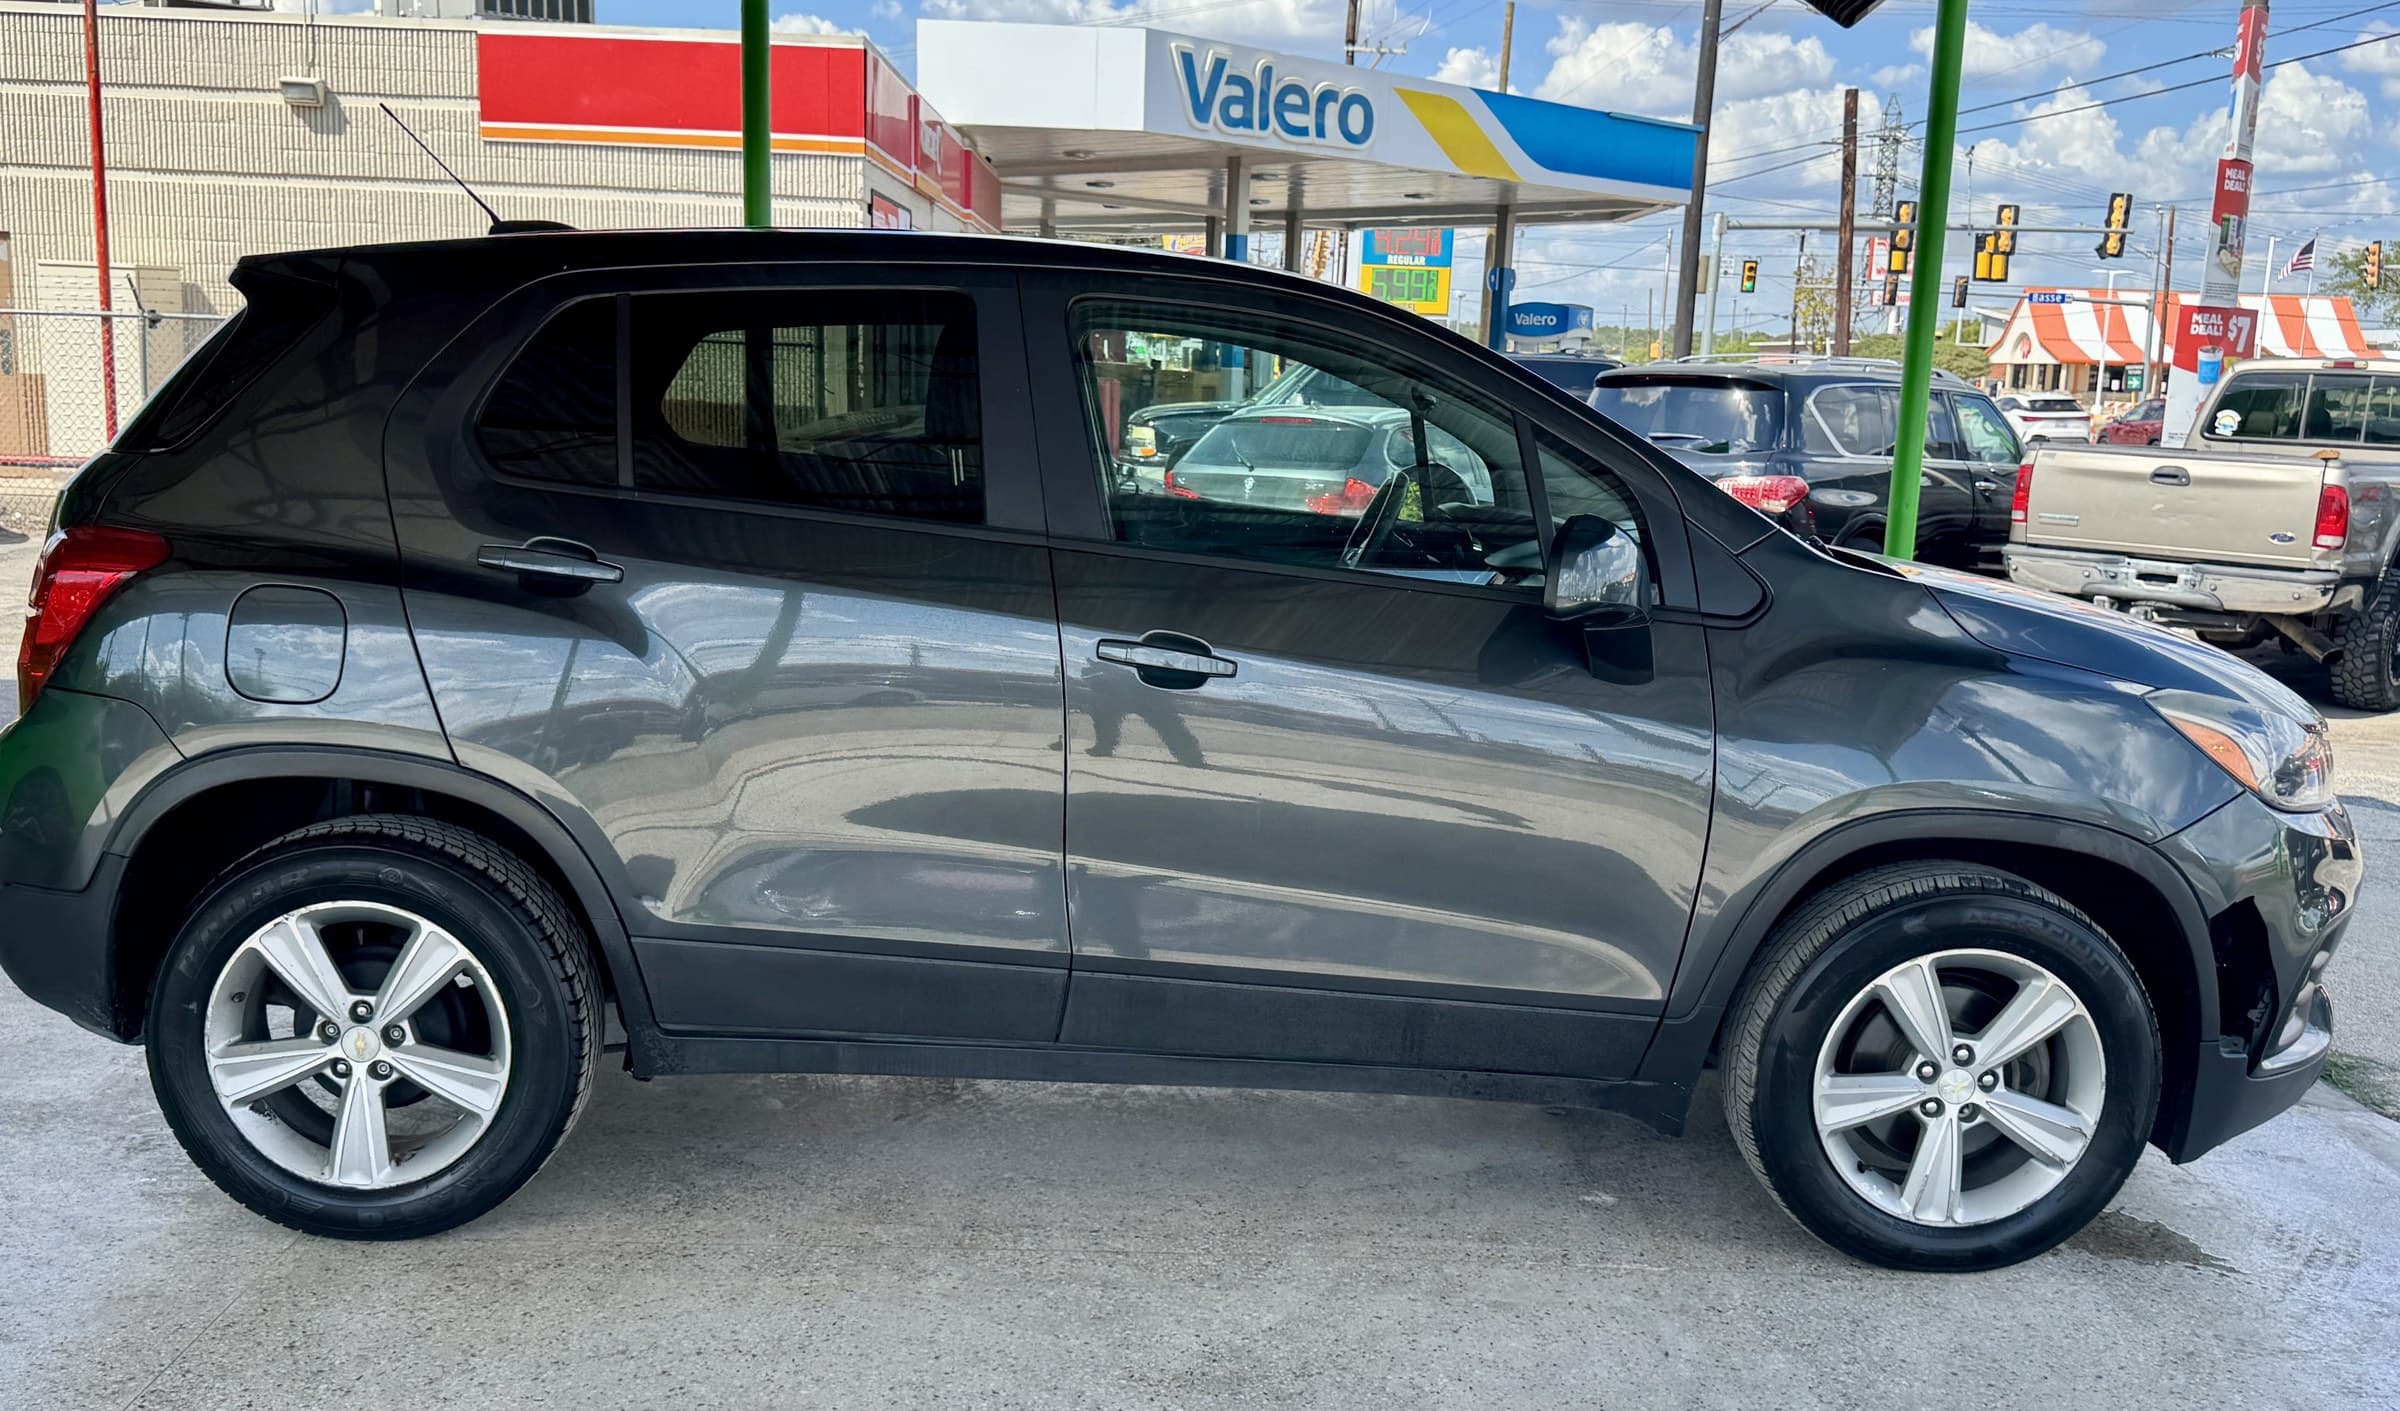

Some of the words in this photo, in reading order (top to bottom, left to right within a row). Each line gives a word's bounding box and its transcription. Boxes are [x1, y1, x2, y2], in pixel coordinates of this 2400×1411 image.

[1179, 50, 1375, 146] Valero
[2224, 167, 2246, 181] MEAL
[1386, 254, 1426, 266] REGULAR
[1514, 312, 1557, 326] Valero
[2191, 312, 2223, 325] MEAL
[2189, 324, 2223, 336] DEAL!
[2227, 314, 2252, 353] $7
